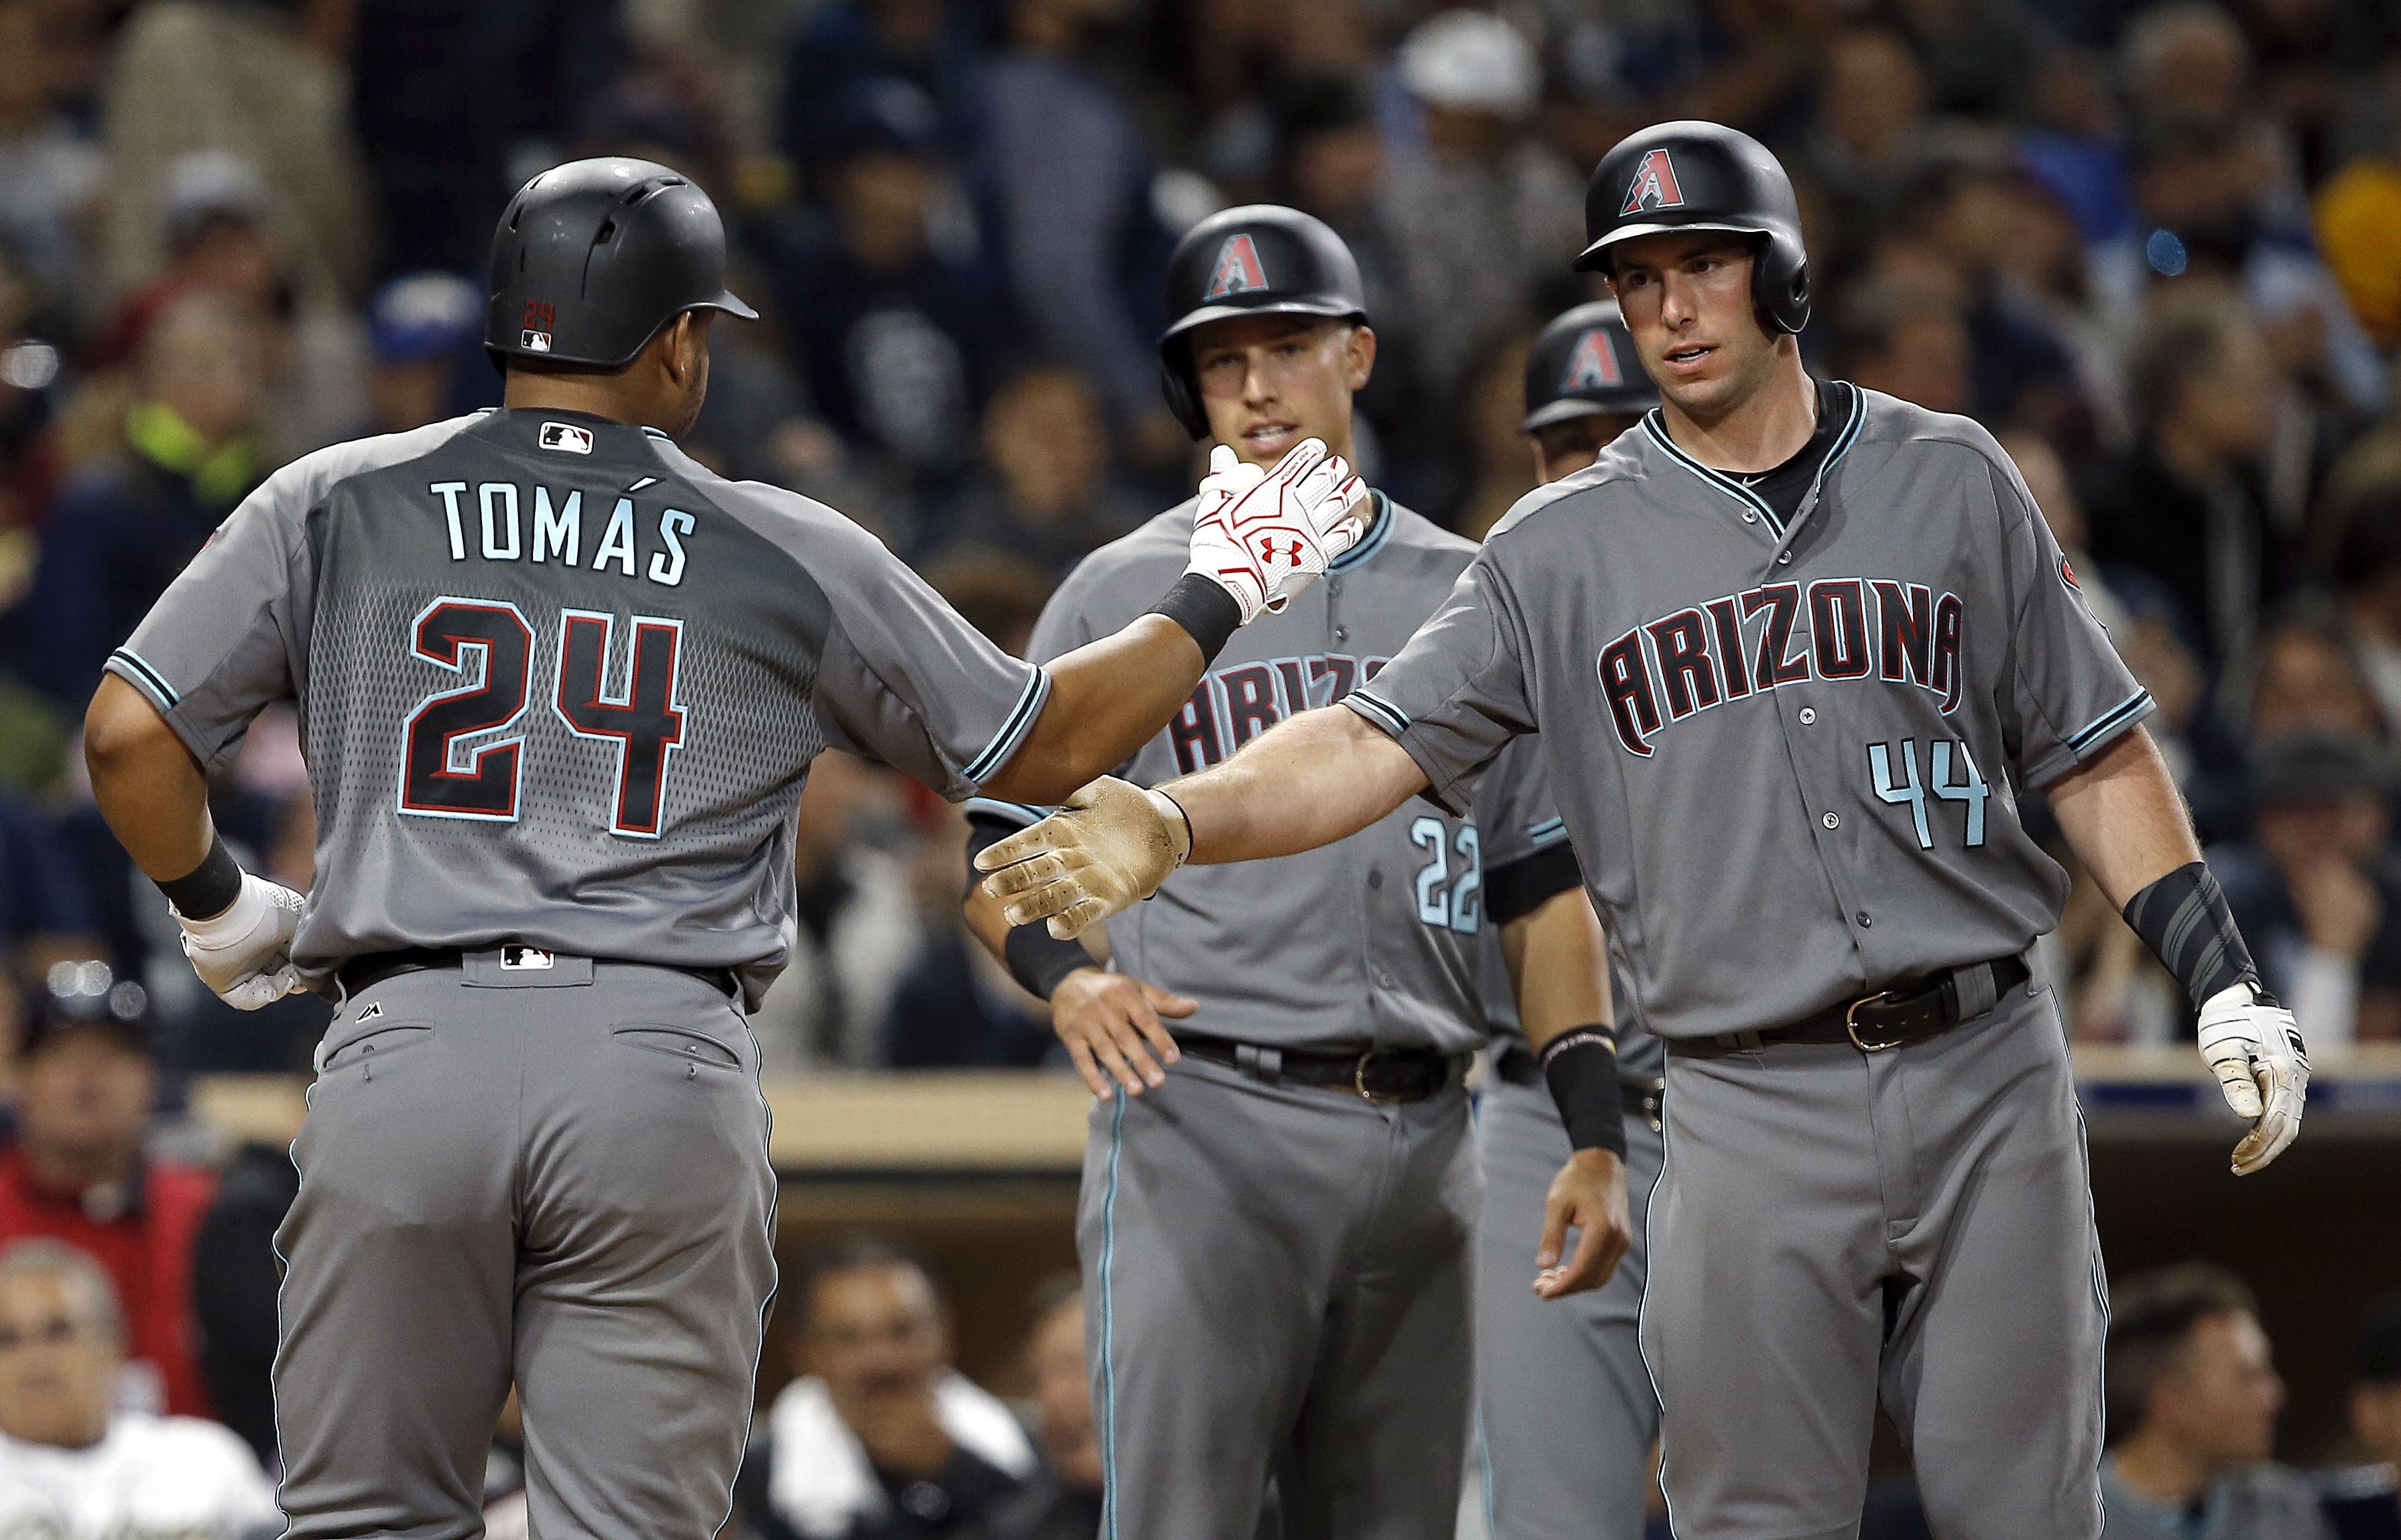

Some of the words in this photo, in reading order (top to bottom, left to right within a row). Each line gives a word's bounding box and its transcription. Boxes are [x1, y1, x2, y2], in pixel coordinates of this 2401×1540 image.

[524, 300, 555, 330] 24
[429, 476, 696, 586] TOMÁS
[396, 595, 688, 840] 24
[1166, 650, 1394, 777] ARIZ
[1597, 576, 1964, 758] ARIZONA
[1866, 737, 1989, 850] 44
[1410, 816, 1481, 935] 22
